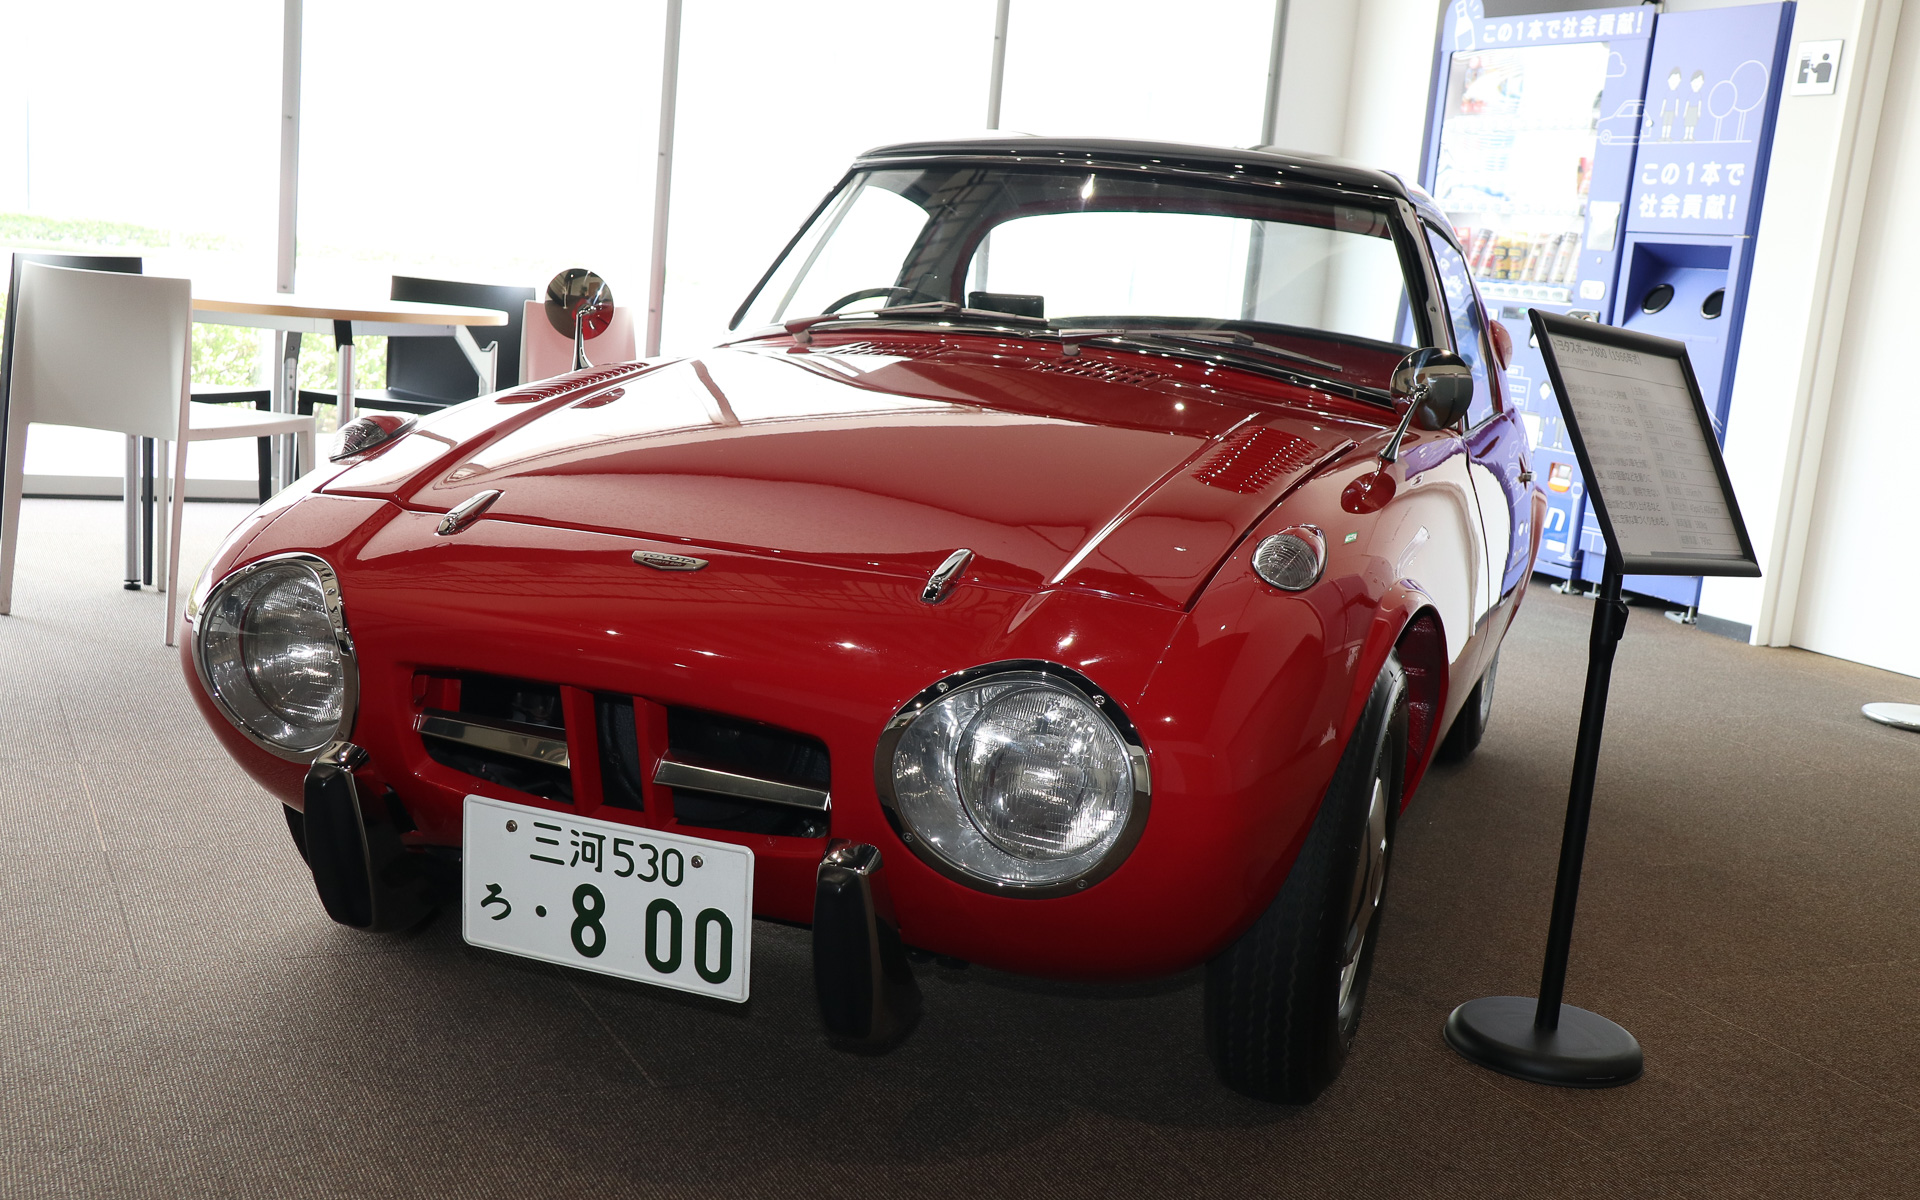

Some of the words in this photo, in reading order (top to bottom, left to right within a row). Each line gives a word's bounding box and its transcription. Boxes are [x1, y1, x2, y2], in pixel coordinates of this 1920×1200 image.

[1641, 161, 1745, 187] この1本で
[643, 552, 697, 564] TOYOTA
